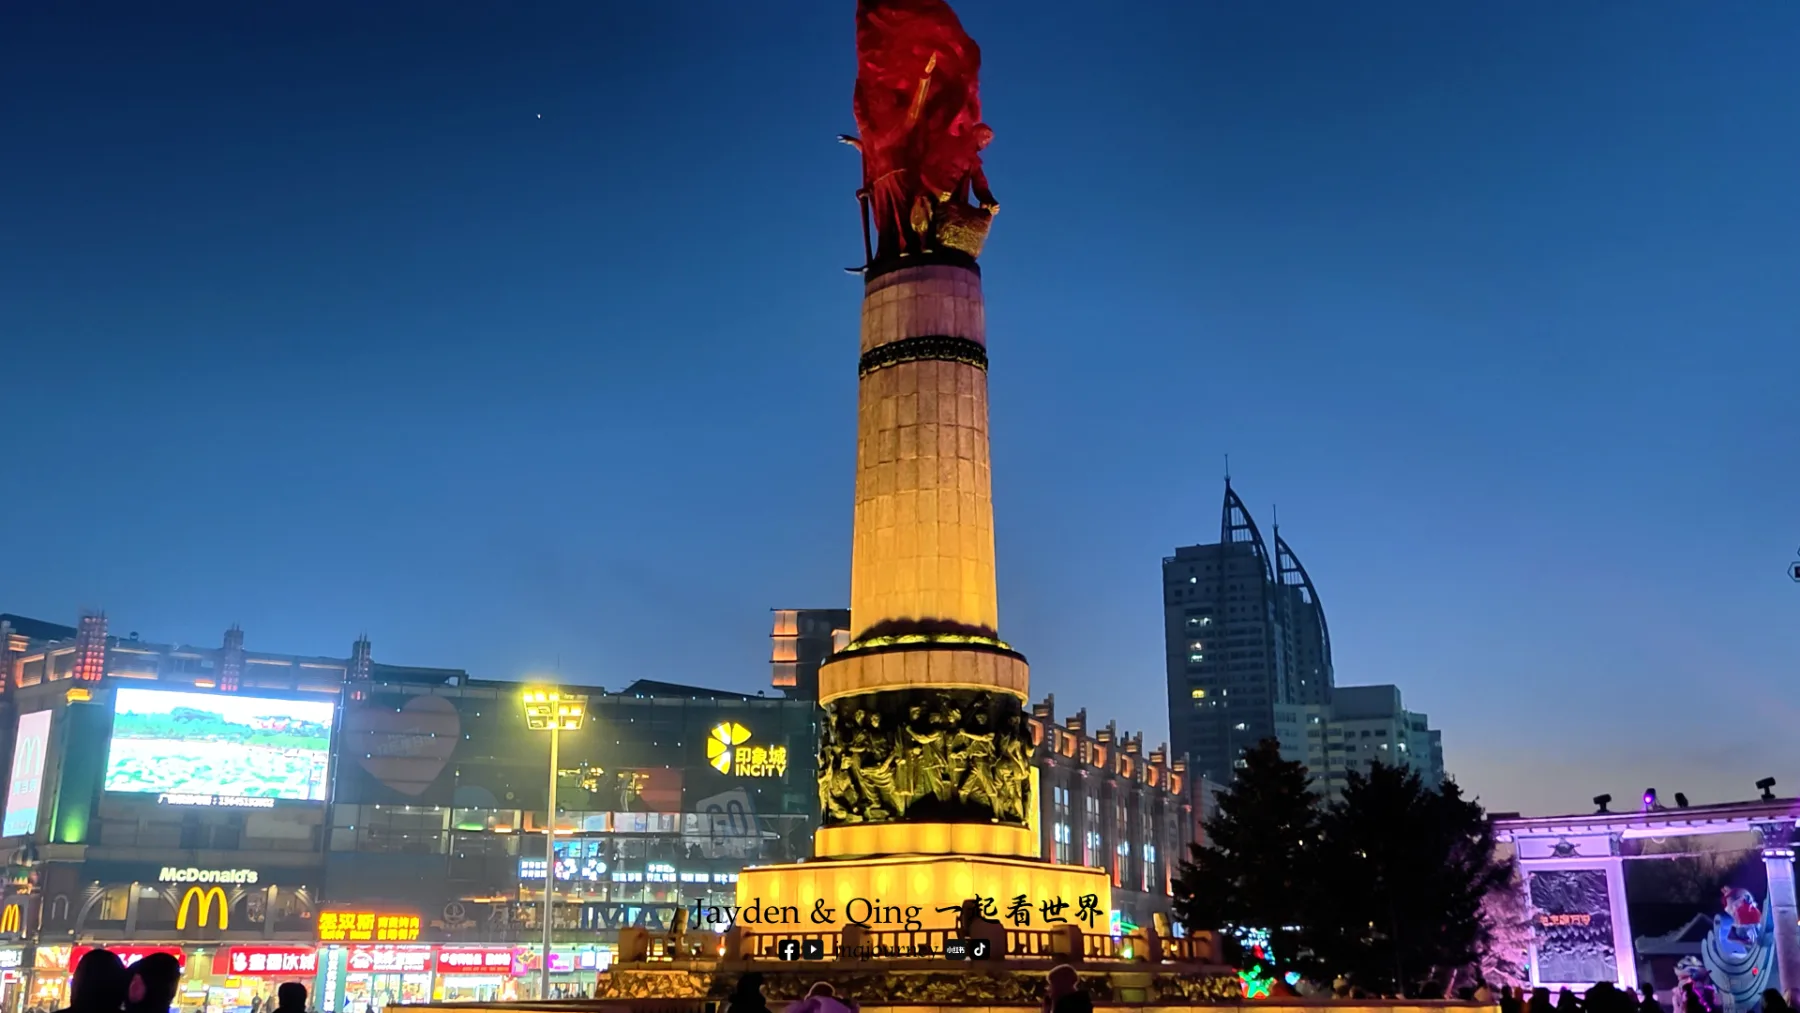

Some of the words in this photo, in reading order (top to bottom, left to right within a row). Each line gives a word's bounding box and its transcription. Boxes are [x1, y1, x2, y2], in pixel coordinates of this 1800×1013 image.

[735, 744, 787, 764] 印象城
[735, 763, 787, 778] INCITY
[159, 867, 258, 884] McDonald's
